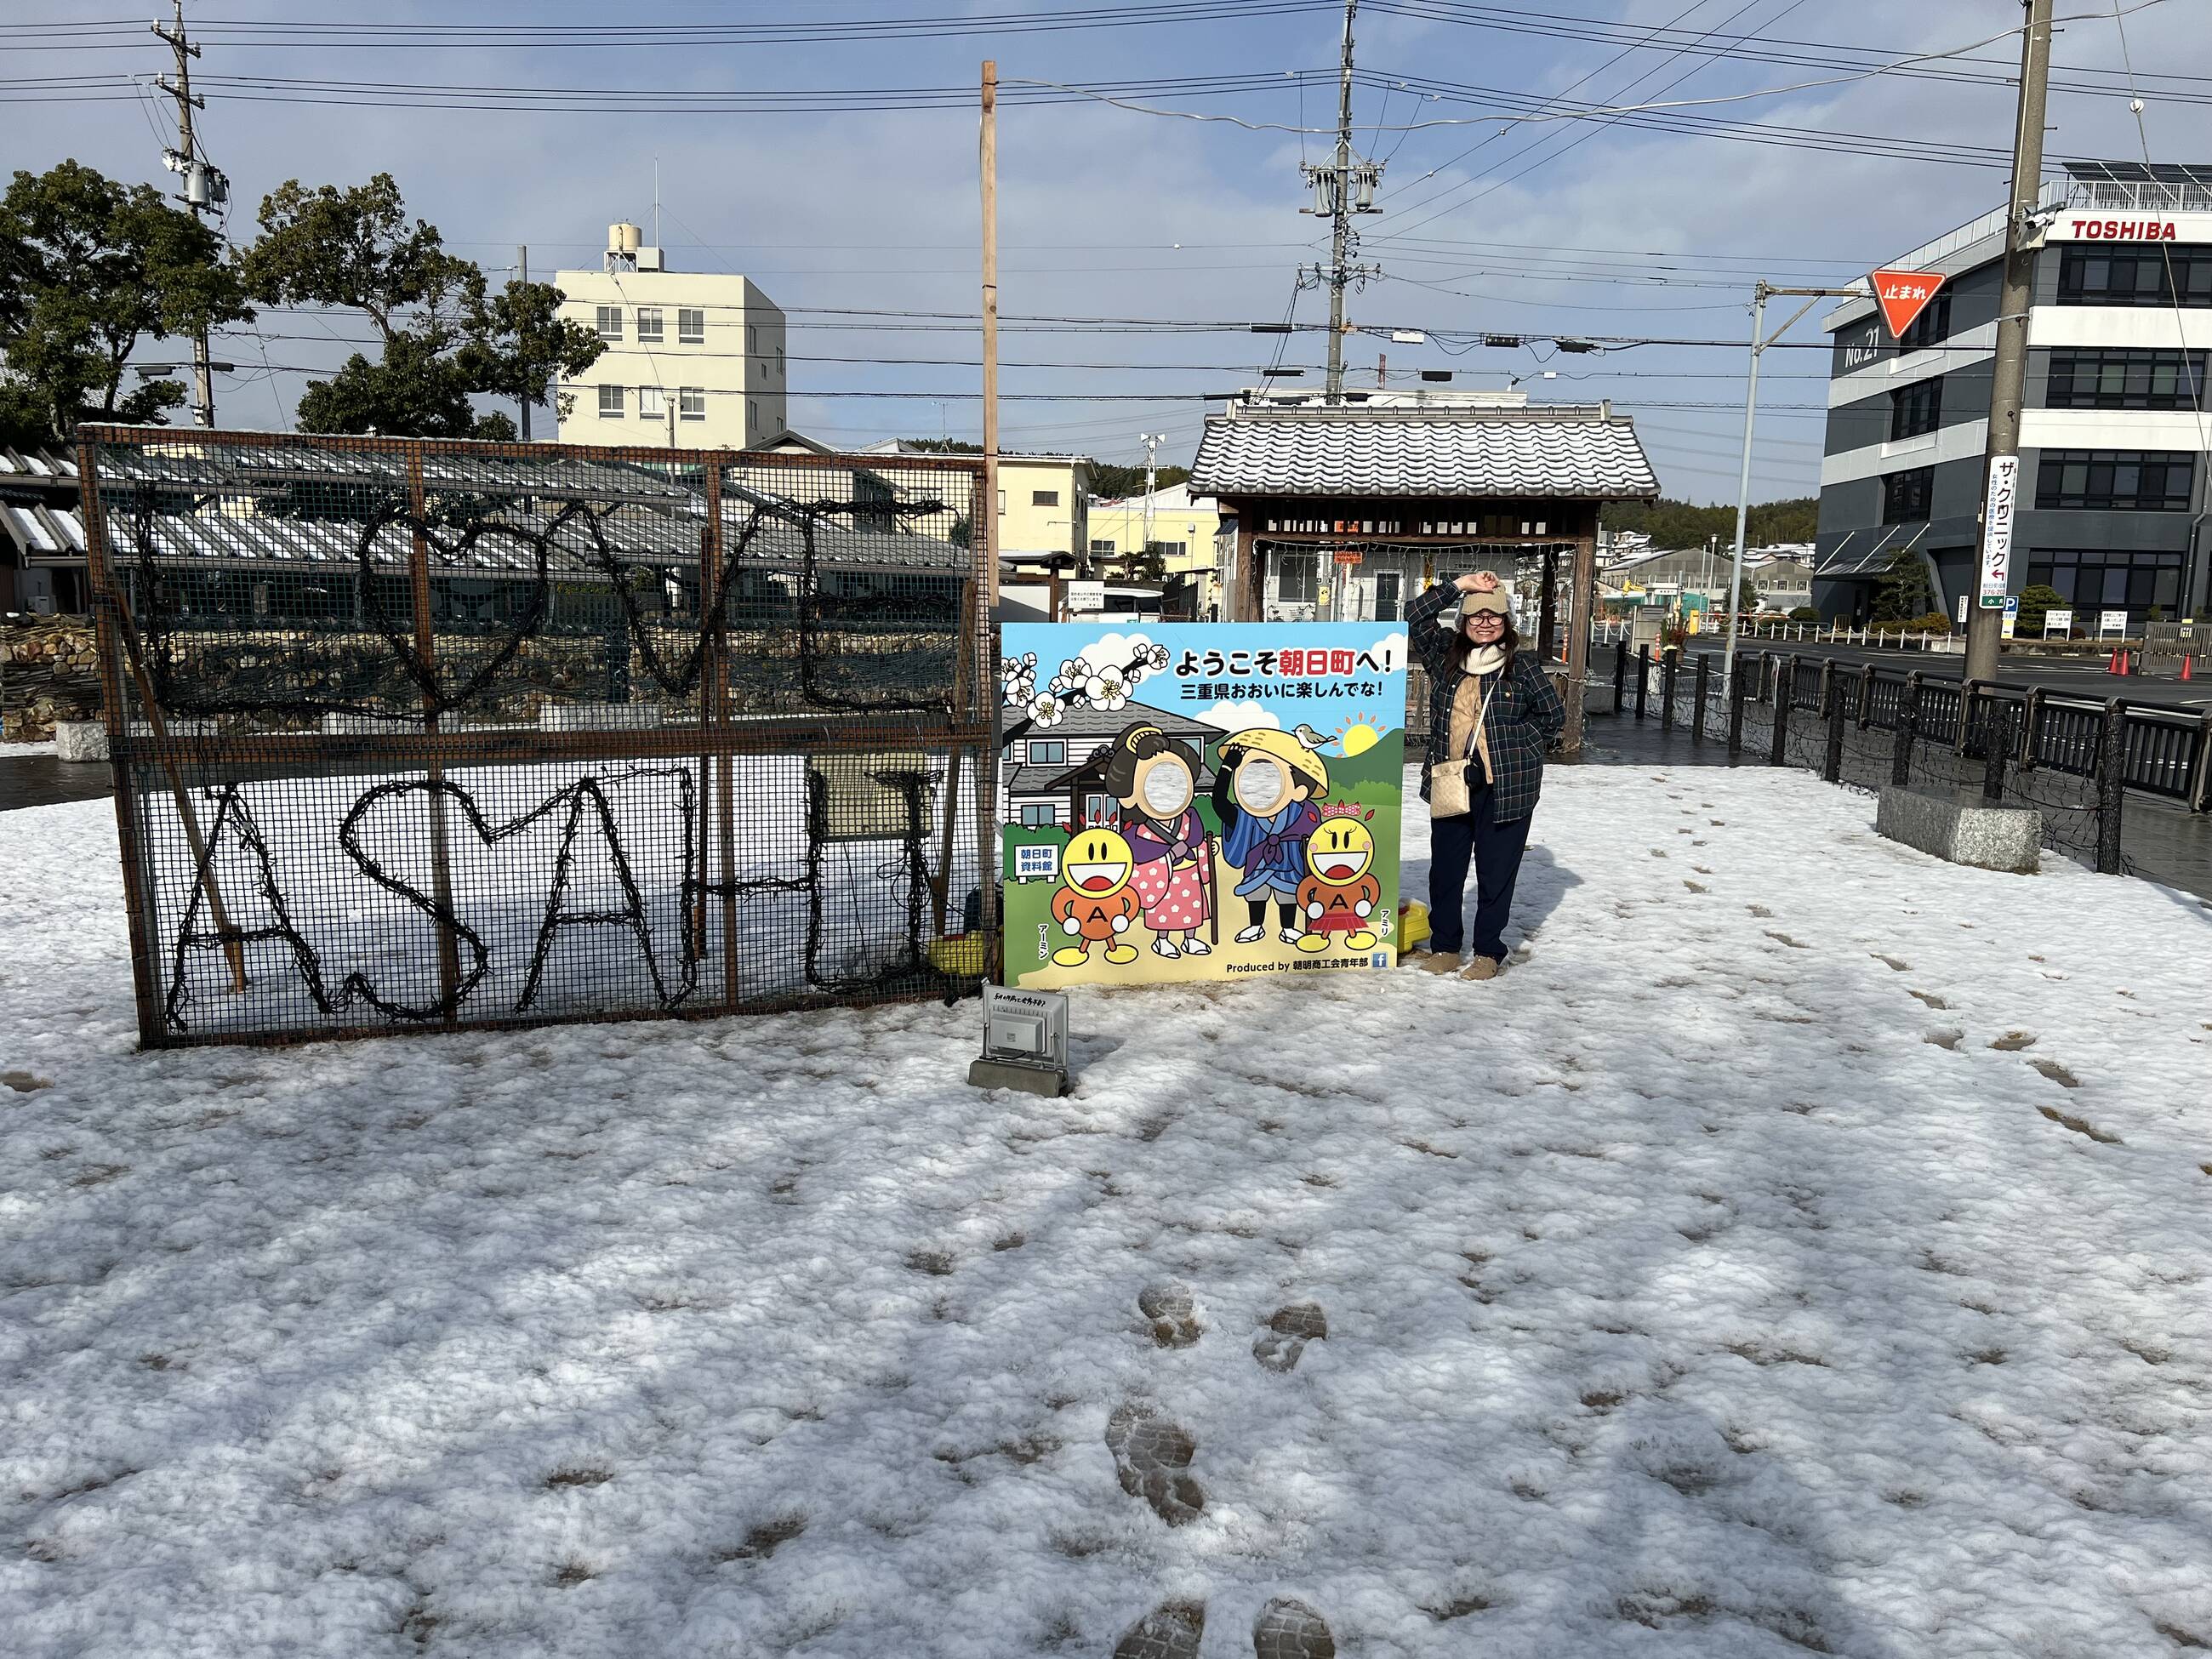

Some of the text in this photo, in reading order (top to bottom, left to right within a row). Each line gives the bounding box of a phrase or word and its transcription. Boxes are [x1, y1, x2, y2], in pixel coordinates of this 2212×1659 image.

[2072, 220, 2175, 240] TOSHIBA
[1883, 283, 1926, 300] 止まれ
[1844, 324, 1880, 368] No.21
[1992, 462, 2015, 567] ザ・クリニック
[2004, 597, 2015, 611] P
[1176, 649, 1391, 676] ようこそ朝日町へ!
[1180, 681, 1382, 700] 三重県おおいに楽しんでな!
[1020, 849, 1052, 859] 朝日町
[1020, 861, 1052, 872] 資料館
[166, 766, 956, 1031] ASAHI
[1328, 893, 1349, 910] A
[1086, 906, 1109, 924] A
[1381, 909, 1389, 936] アミリ
[1039, 924, 1048, 960] アーミン
[1226, 957, 1369, 973] Produced by 朝明商工会青年部
